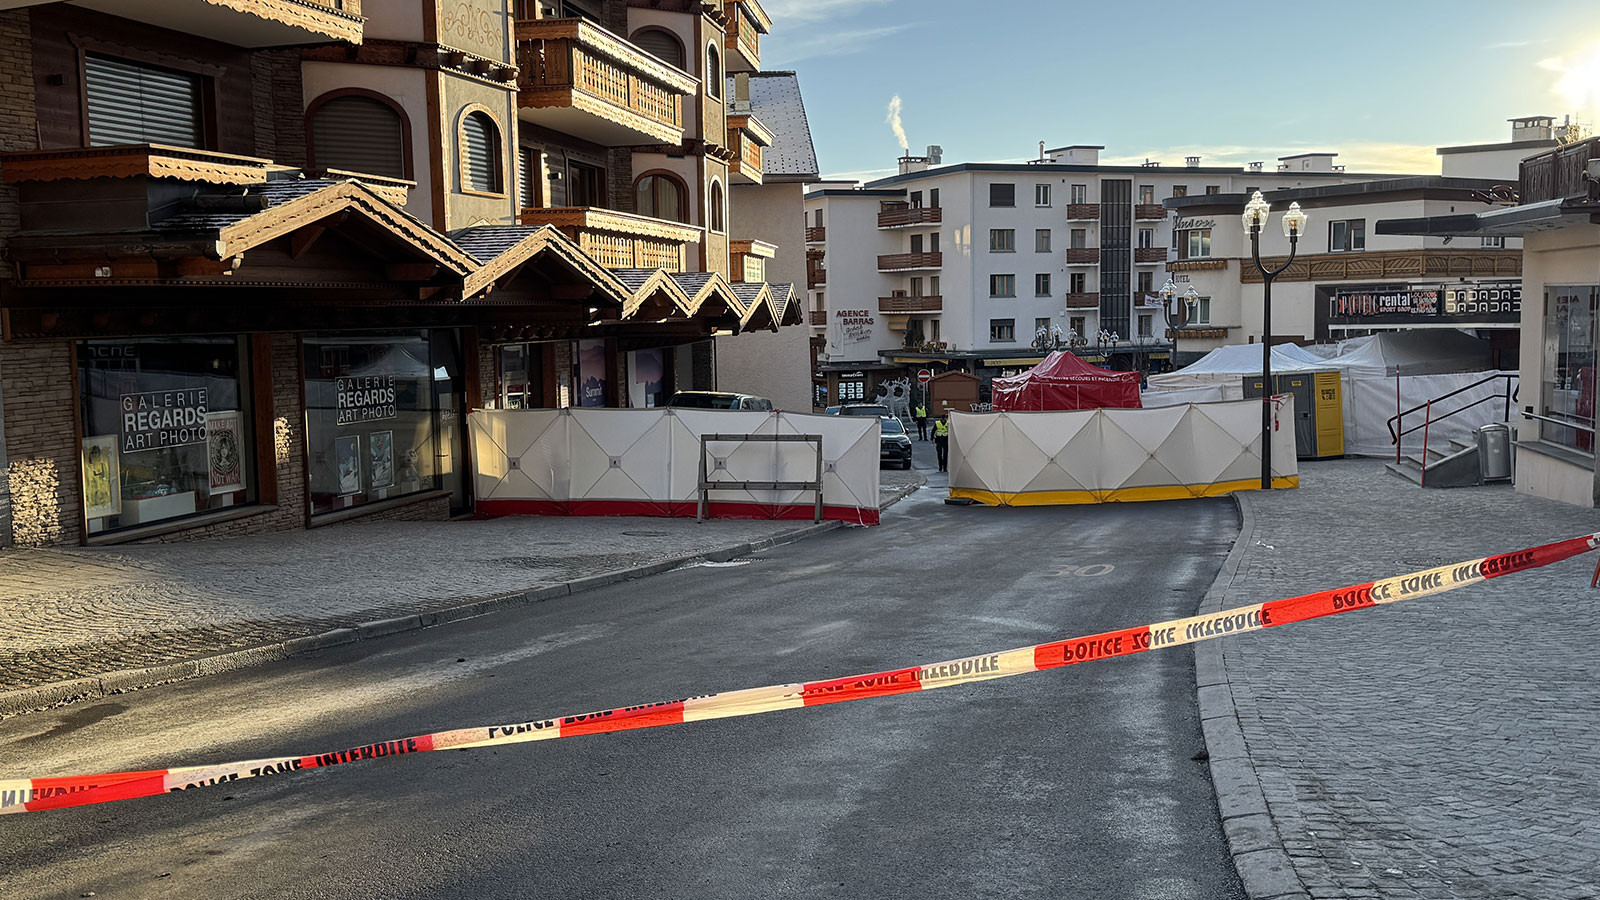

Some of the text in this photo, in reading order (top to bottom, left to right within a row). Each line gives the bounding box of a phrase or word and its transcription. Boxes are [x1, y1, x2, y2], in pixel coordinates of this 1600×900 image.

[1380, 293, 1410, 306] rental
[836, 310, 869, 318] AGENCE
[843, 318, 874, 326] BARRAS
[337, 375, 394, 391] GALERIE
[123, 390, 206, 411] GALERIE
[338, 388, 395, 409] REGARDS
[124, 406, 206, 432] REGARDS
[338, 404, 395, 422] ART PHOTO
[125, 426, 207, 450] ART PHOTO
[1041, 564, 1115, 577] 30
[316, 739, 417, 768] INTERDITE
